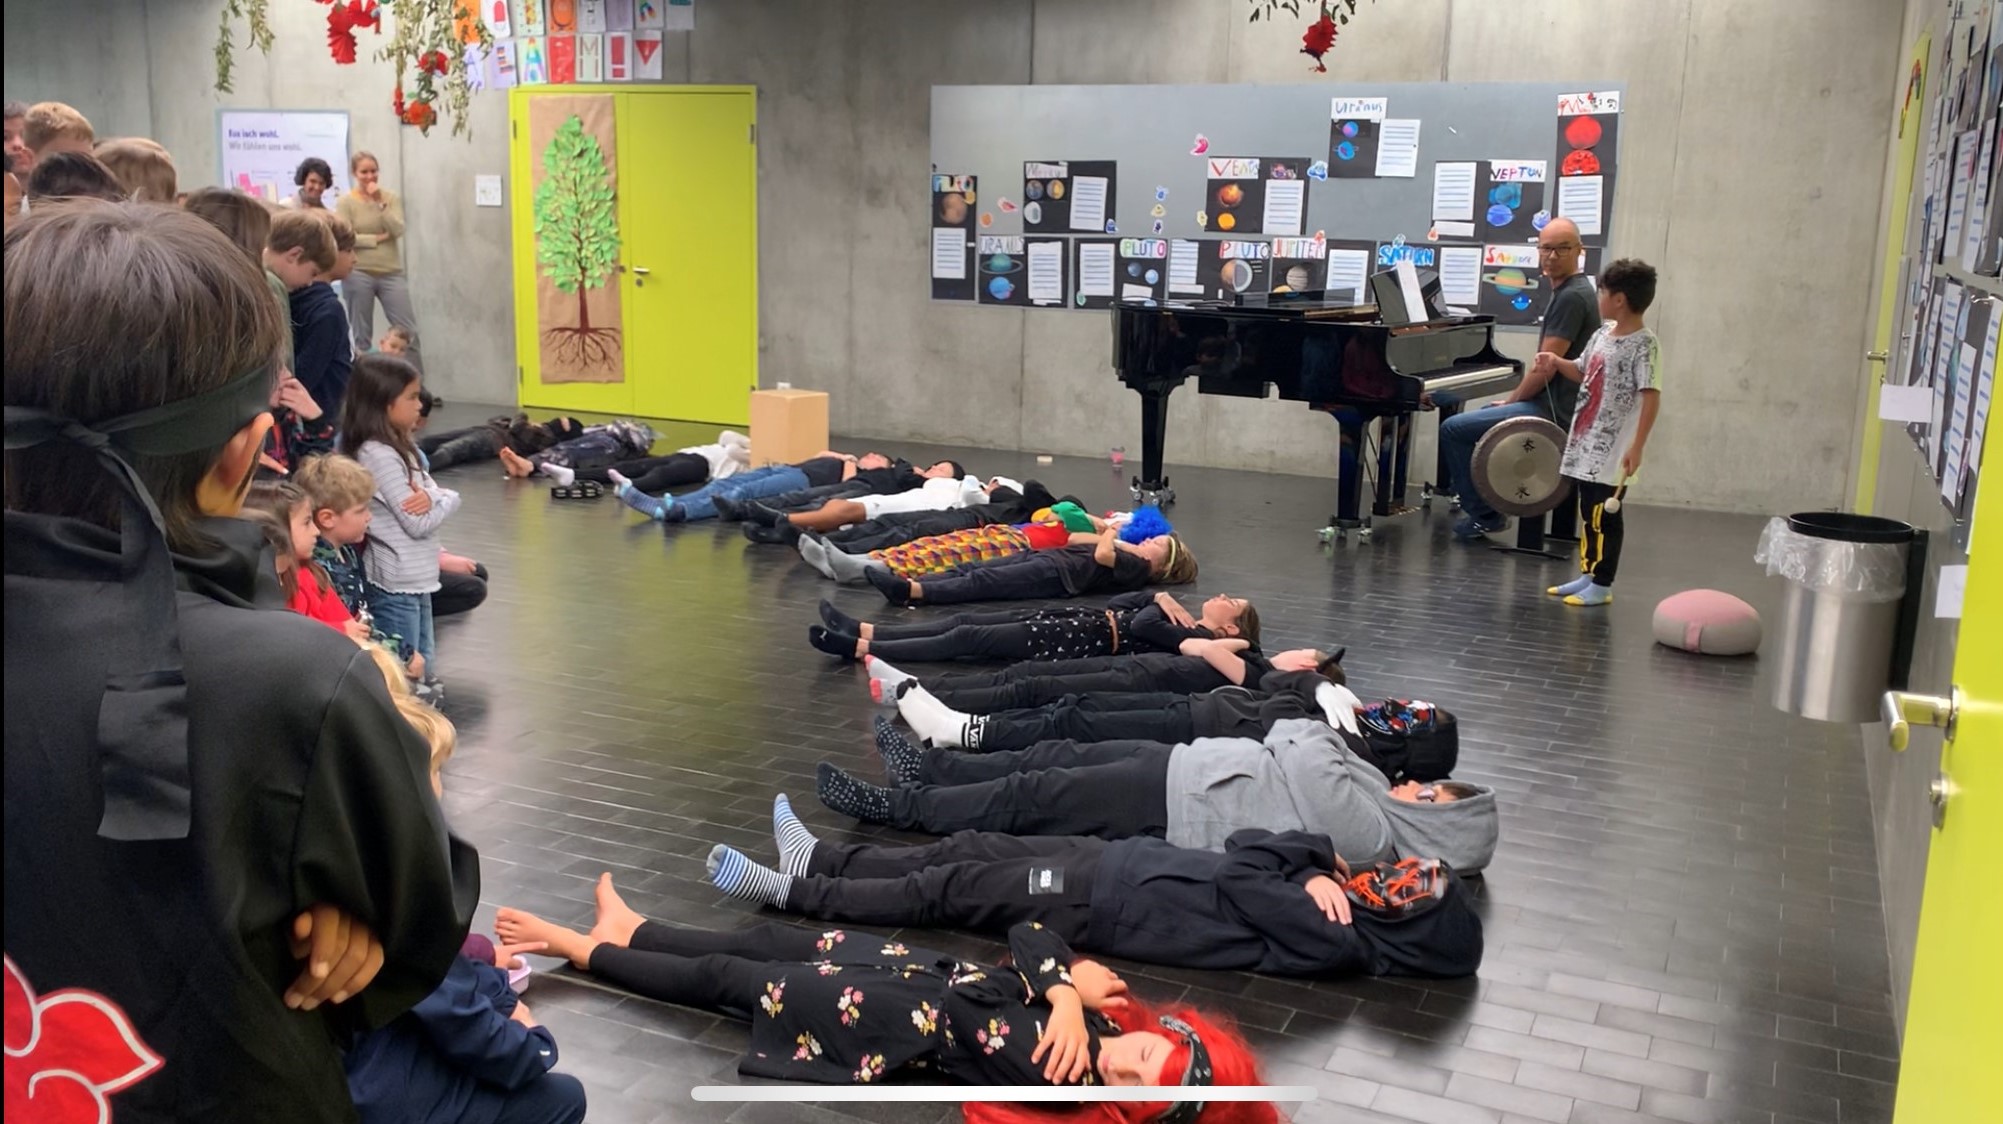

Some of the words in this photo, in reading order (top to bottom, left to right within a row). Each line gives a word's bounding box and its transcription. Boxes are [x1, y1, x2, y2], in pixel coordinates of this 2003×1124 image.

[1334, 101, 1384, 116] Uranus
[1122, 240, 1166, 257] PLUTO
[1220, 240, 1270, 259] PLUTO
